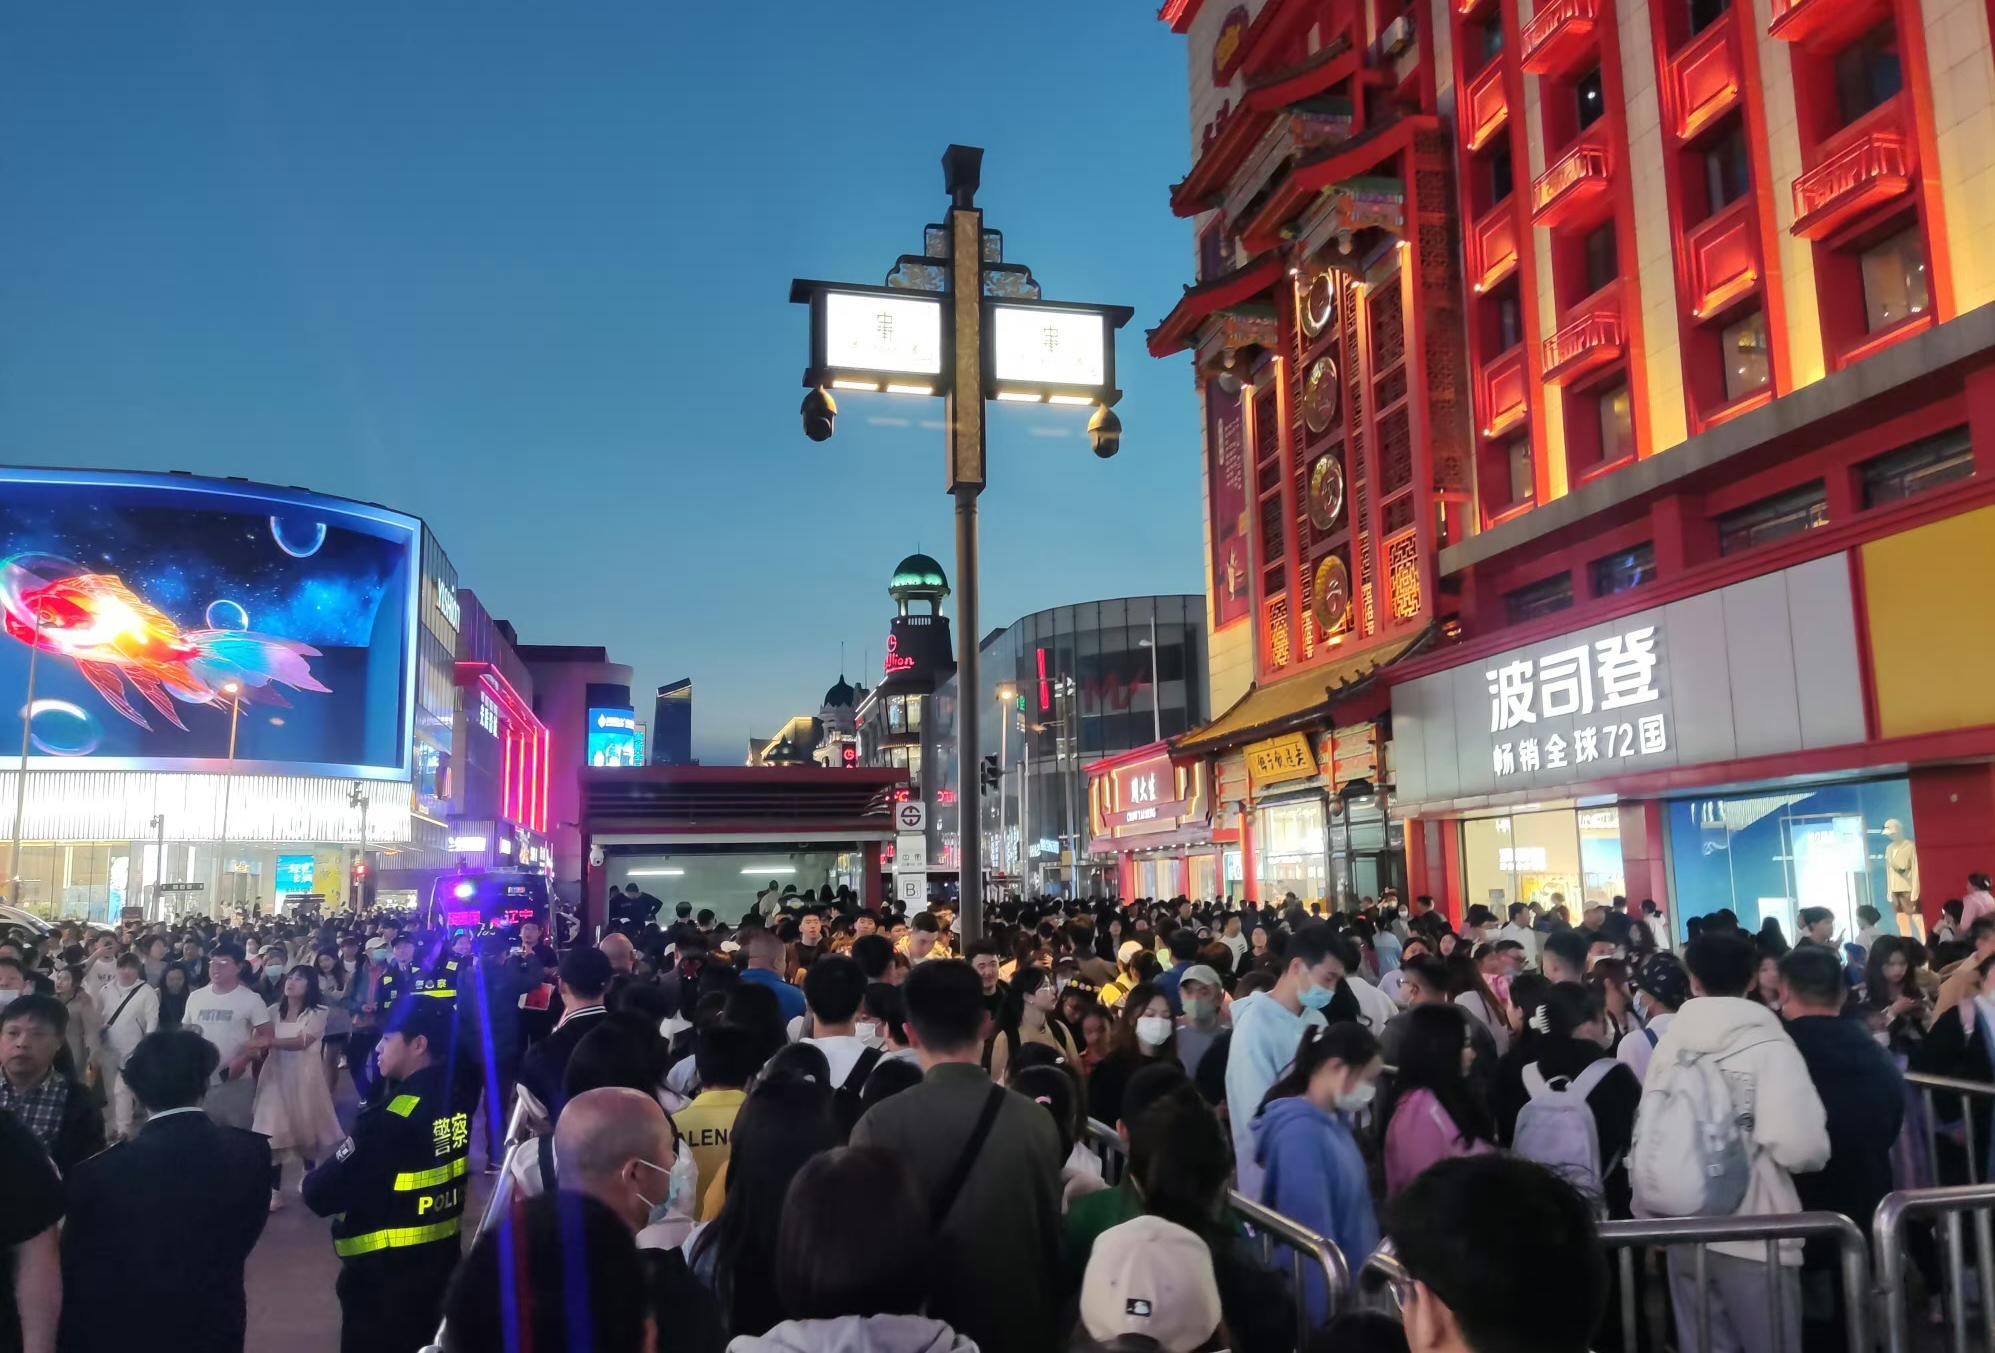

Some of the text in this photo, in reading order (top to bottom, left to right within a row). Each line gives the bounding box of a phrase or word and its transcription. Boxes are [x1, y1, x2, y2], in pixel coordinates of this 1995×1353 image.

[1485, 626, 1660, 733] 波司登
[1493, 713, 1667, 777] 畅销全球72国
[432, 1112, 468, 1157] 警察
[417, 1187, 462, 1216] POLI
